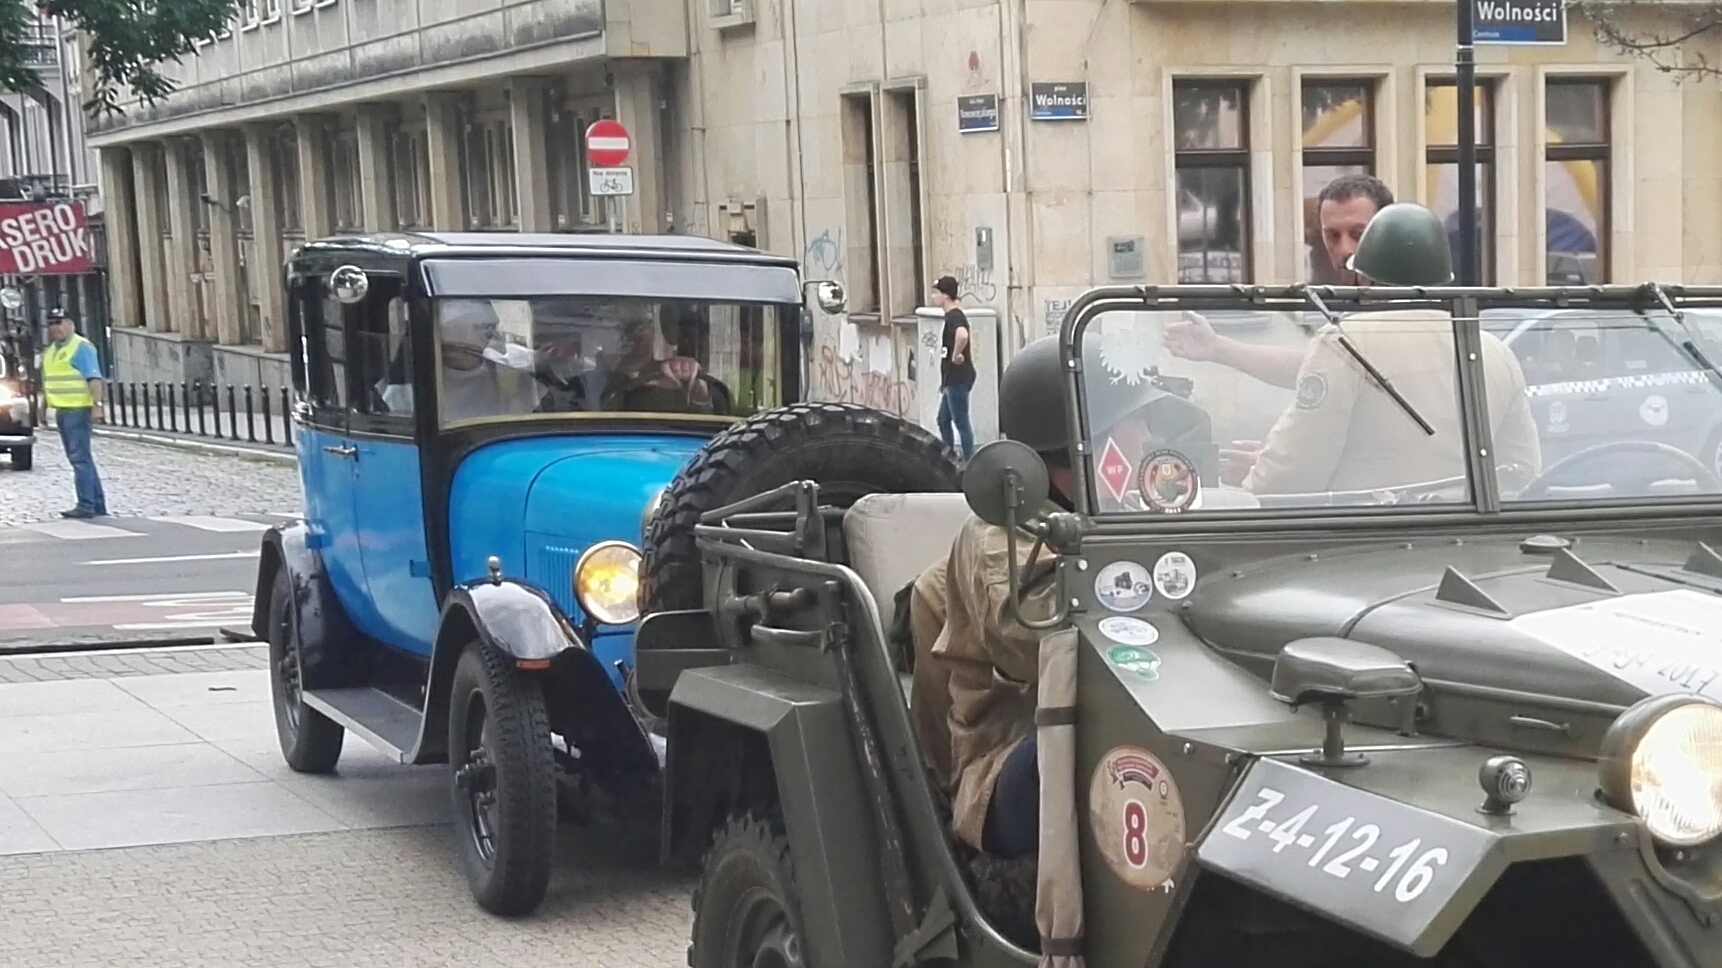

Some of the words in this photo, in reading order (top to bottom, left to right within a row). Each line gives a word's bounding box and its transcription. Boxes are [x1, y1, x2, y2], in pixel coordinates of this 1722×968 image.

[1477, 1, 1557, 21] Wolności
[1035, 93, 1086, 106] Wolności
[0, 204, 76, 250] SERO
[12, 227, 88, 273] DRUK
[1106, 465, 1123, 475] WP
[1124, 800, 1148, 869] 8
[1223, 787, 1448, 902] Z-4-12-16
